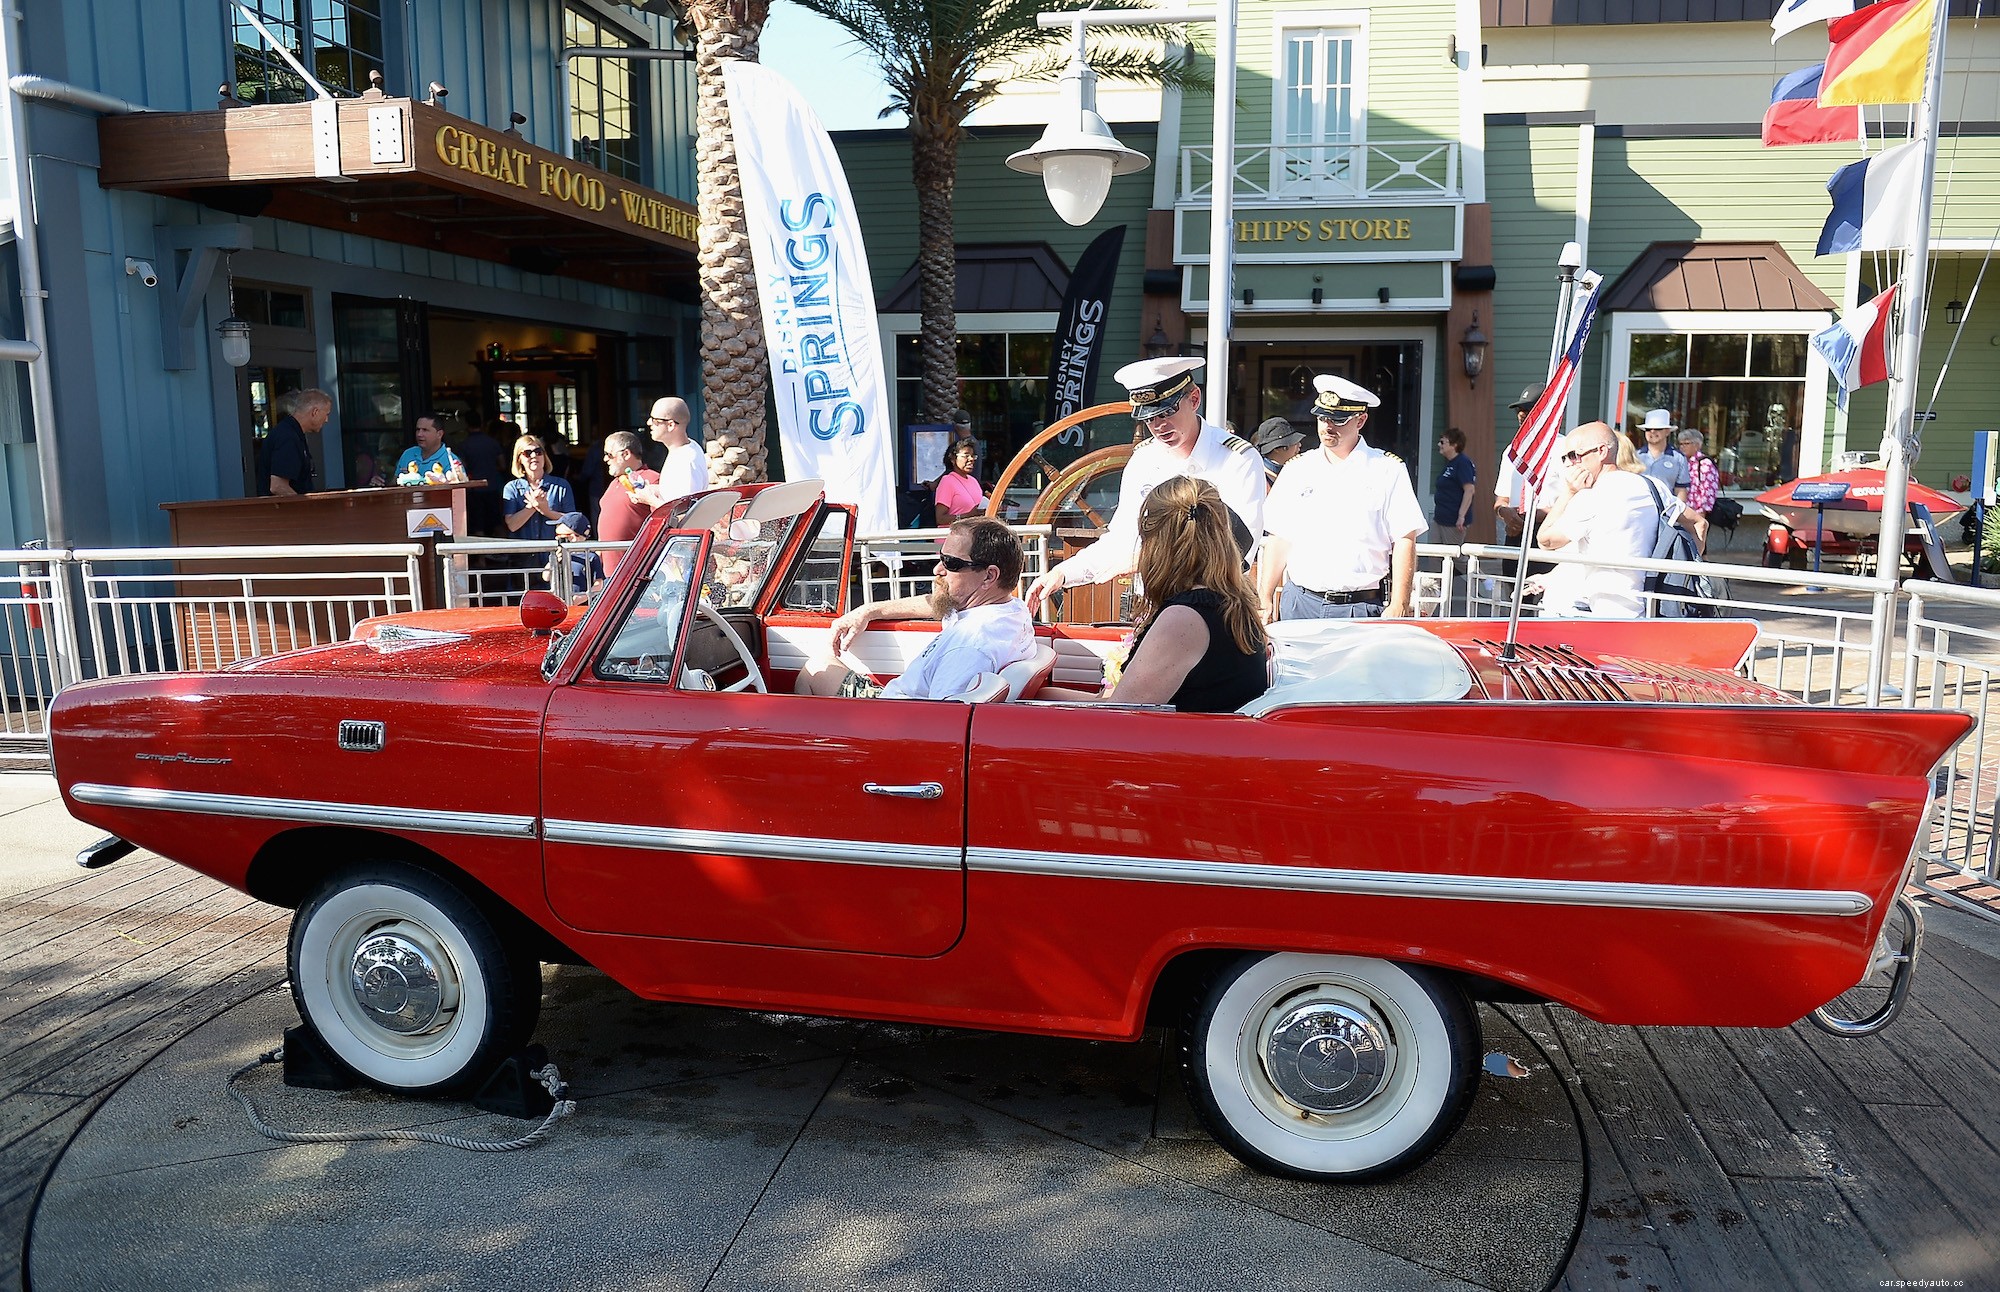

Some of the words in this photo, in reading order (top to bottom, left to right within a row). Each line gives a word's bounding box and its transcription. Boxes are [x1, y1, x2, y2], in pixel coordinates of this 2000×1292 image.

[435, 125, 532, 189] GREAT
[539, 160, 606, 212] FOOD
[1235, 219, 1312, 242] HIP'S
[1318, 218, 1411, 241] STORE
[780, 192, 865, 441] SPRINGS
[1055, 339, 1073, 401] DISNEY
[1058, 299, 1104, 447] SPRINGS
